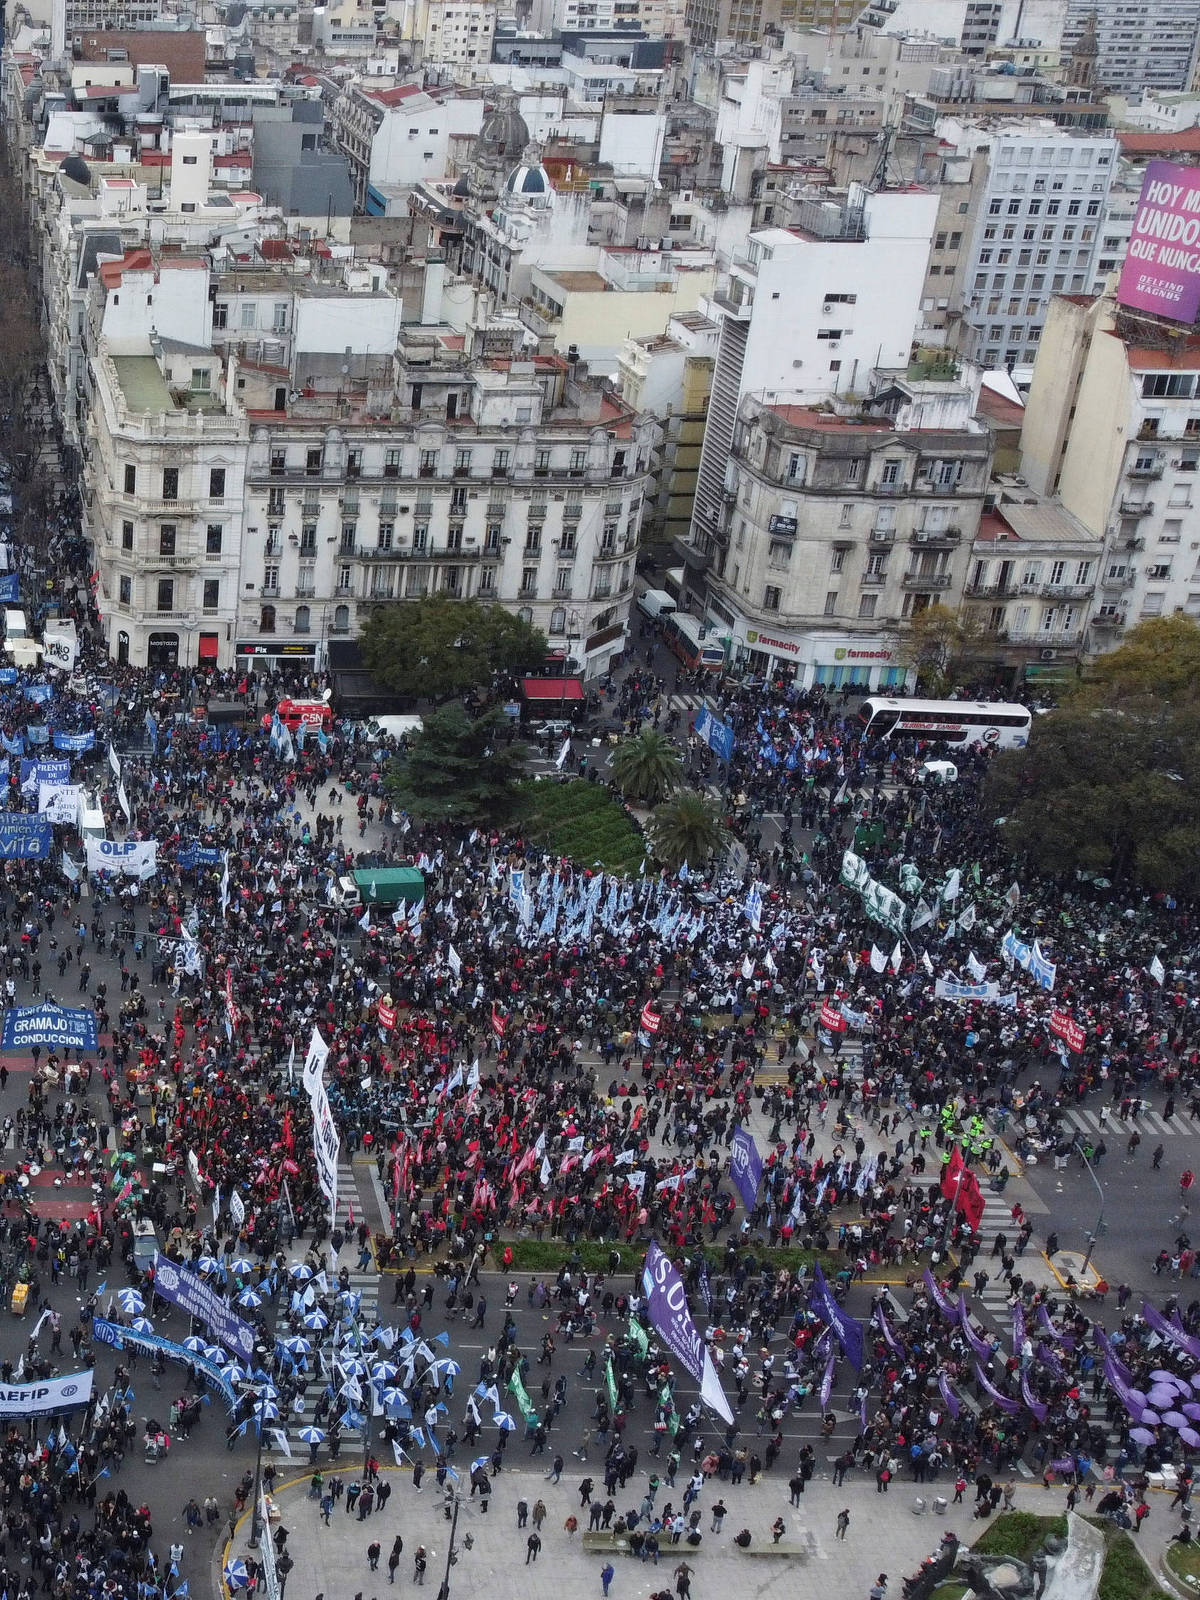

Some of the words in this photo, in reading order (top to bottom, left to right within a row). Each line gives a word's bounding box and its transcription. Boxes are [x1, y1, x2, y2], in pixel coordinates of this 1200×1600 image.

[1146, 180, 1184, 207] HOY
[1130, 239, 1156, 262] QUE
[758, 634, 800, 654] farmacity
[847, 649, 892, 660] farmacity
[301, 713, 324, 723] C5N
[37, 763, 68, 772] FRENTE
[100, 841, 137, 855] OLP
[14, 1017, 67, 1032] GRAMAJO
[13, 1033, 84, 1046] CONDUCCION
